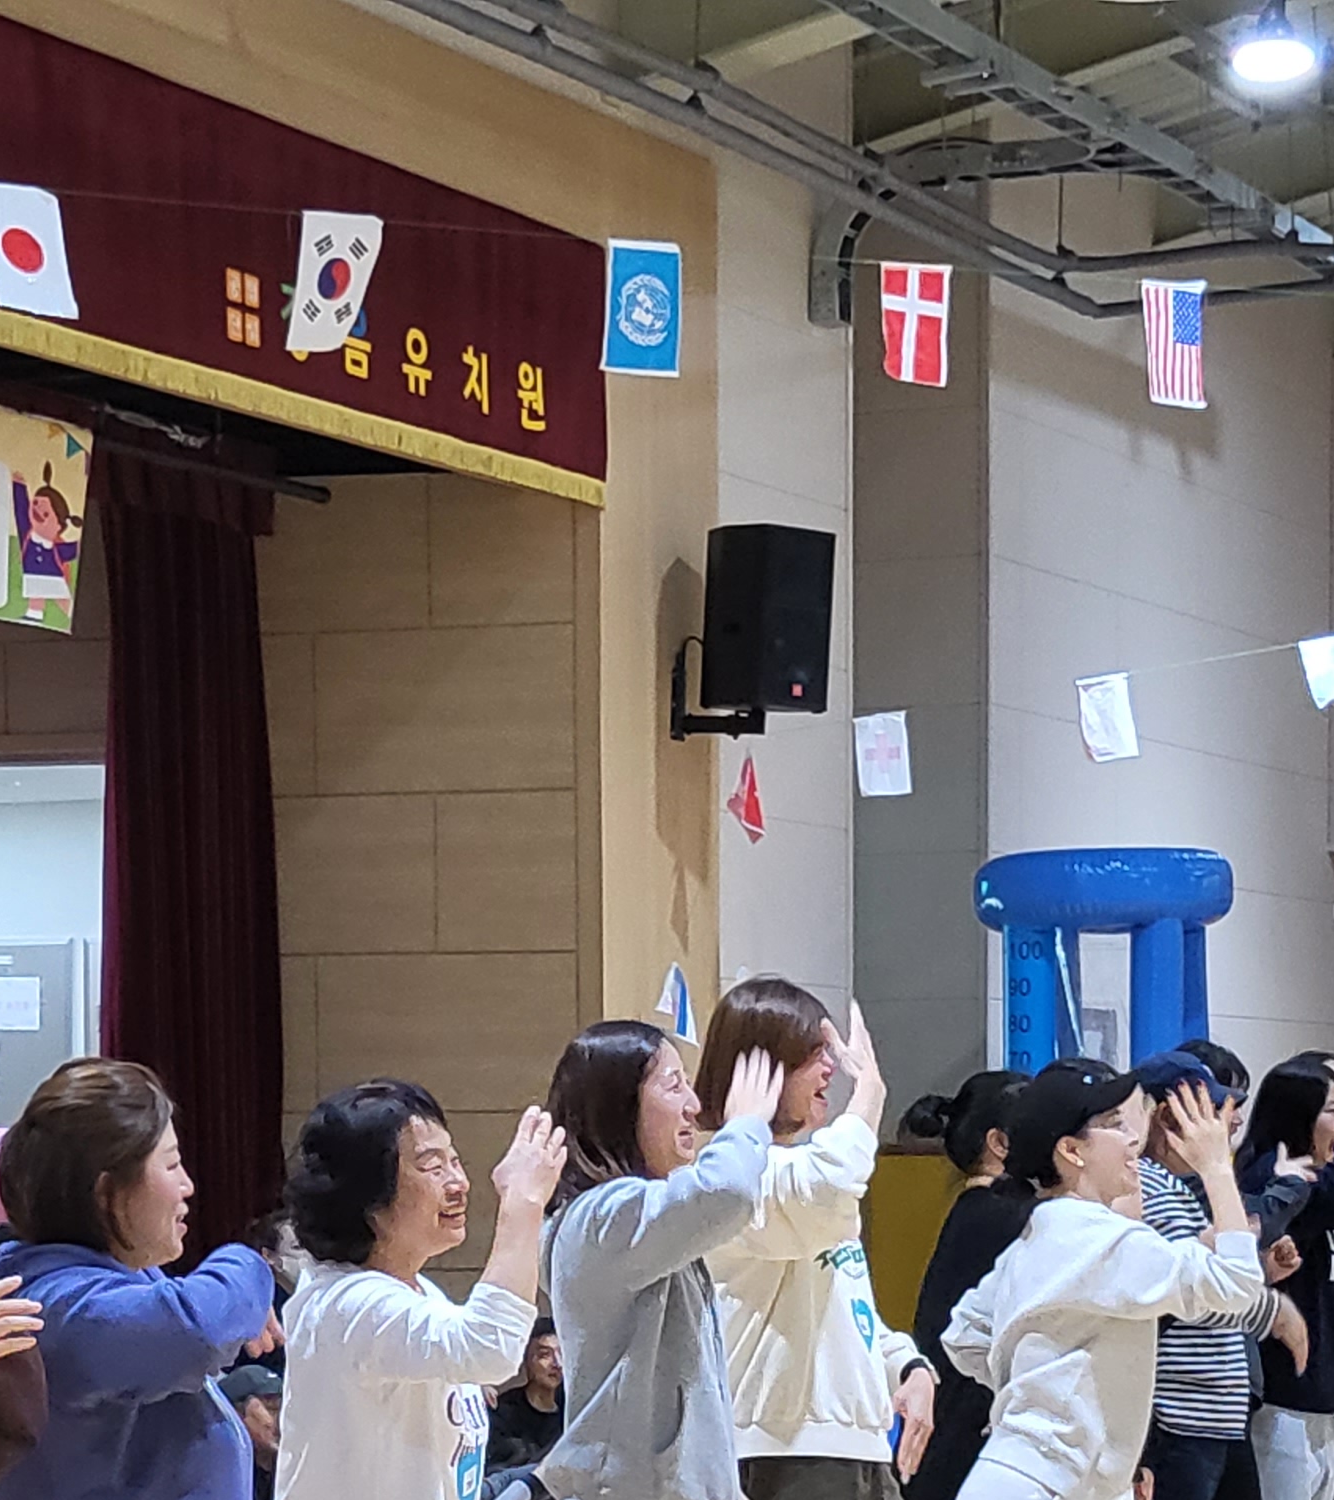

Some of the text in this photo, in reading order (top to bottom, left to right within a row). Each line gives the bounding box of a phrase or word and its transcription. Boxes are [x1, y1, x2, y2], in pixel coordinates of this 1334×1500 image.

[1009, 940, 1043, 961] 100
[1008, 977, 1031, 997] 90
[1008, 1014, 1031, 1033] 80
